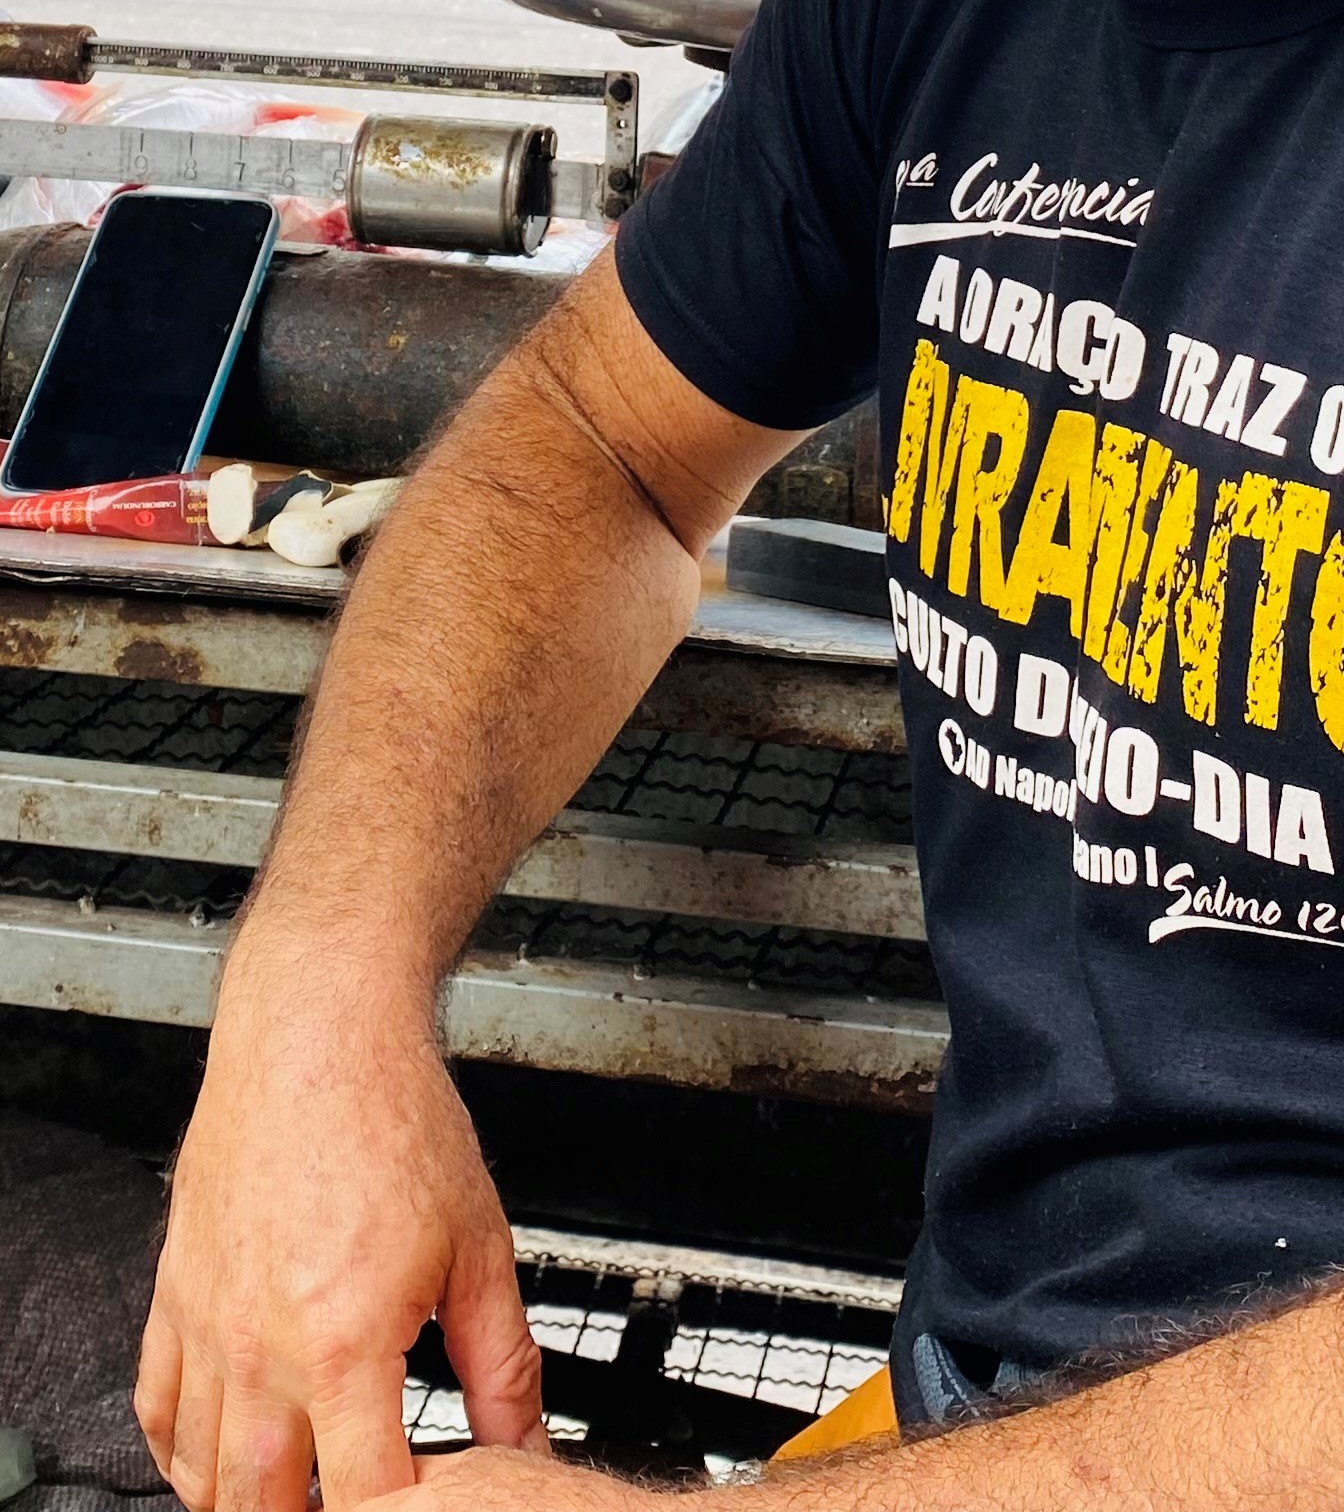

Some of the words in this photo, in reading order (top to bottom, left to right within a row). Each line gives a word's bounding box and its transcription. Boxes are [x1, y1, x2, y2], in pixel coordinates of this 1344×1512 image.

[134, 154, 149, 175] 9
[183, 158, 198, 181] 8
[233, 161, 246, 182] 7
[281, 168, 296, 189] 6
[332, 169, 346, 193] 5
[1160, 331, 1309, 458] TRAZ
[888, 576, 998, 717] CULTO
[966, 738, 990, 790] AD
[1163, 862, 1282, 926] Salmo
